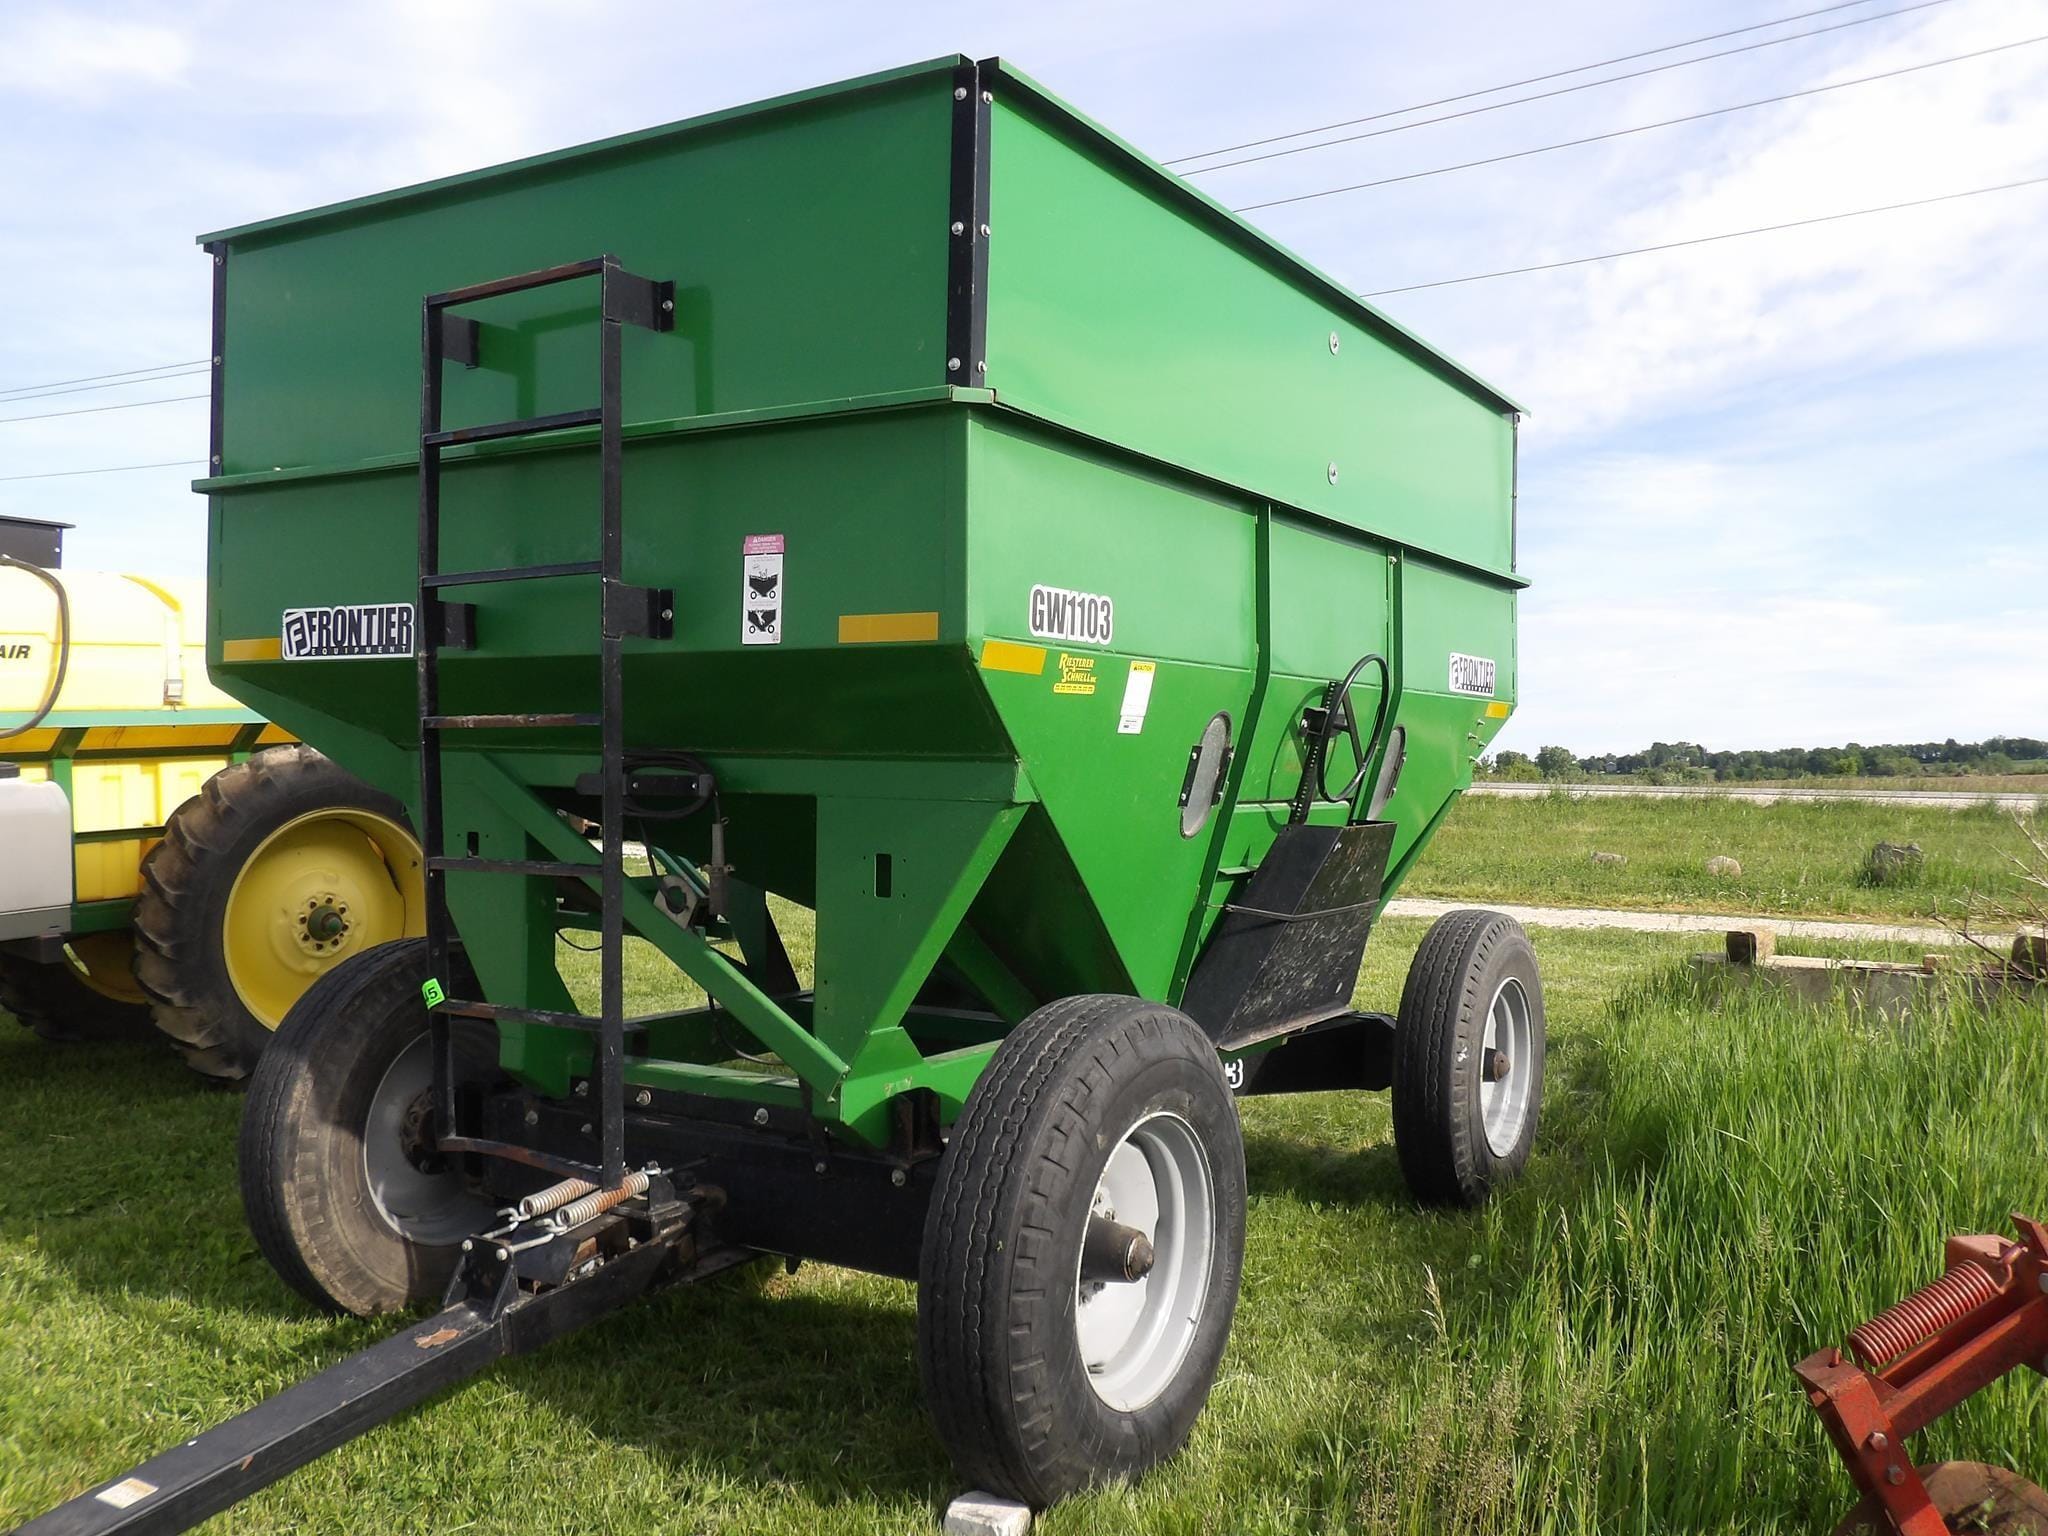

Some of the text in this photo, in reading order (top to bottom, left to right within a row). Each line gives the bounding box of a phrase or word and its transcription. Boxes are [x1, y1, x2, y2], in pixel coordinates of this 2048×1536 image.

[306, 605, 413, 648] FRONTIER
[1032, 588, 1111, 641] GW1103
[311, 645, 407, 656] EQUIPMENT
[1458, 656, 1494, 688] FRONTIER
